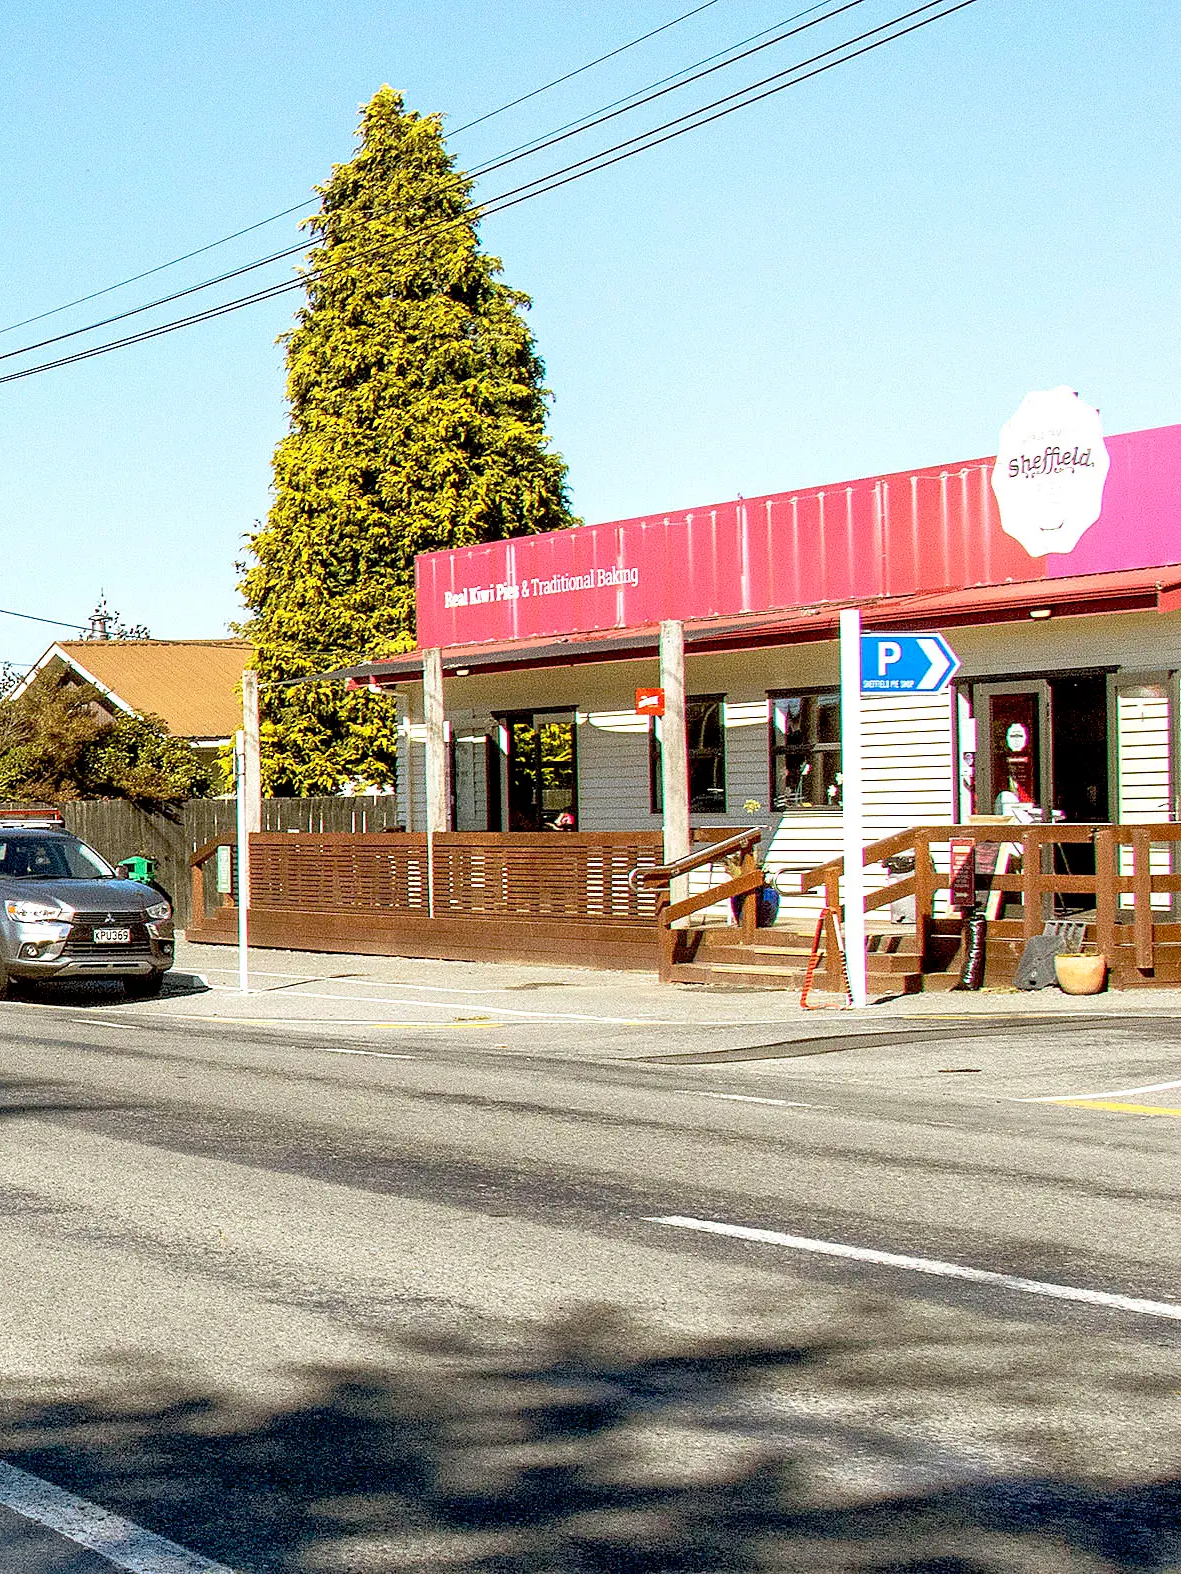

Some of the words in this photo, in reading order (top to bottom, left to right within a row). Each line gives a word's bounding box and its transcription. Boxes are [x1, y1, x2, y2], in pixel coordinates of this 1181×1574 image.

[444, 587, 469, 608] Real
[469, 583, 495, 605] Kiwi
[495, 581, 519, 601] Pies
[521, 580, 530, 597] &
[530, 569, 595, 596] Traditional
[596, 565, 639, 587] Baking
[878, 641, 902, 676] P
[95, 930, 129, 940] KPU369
